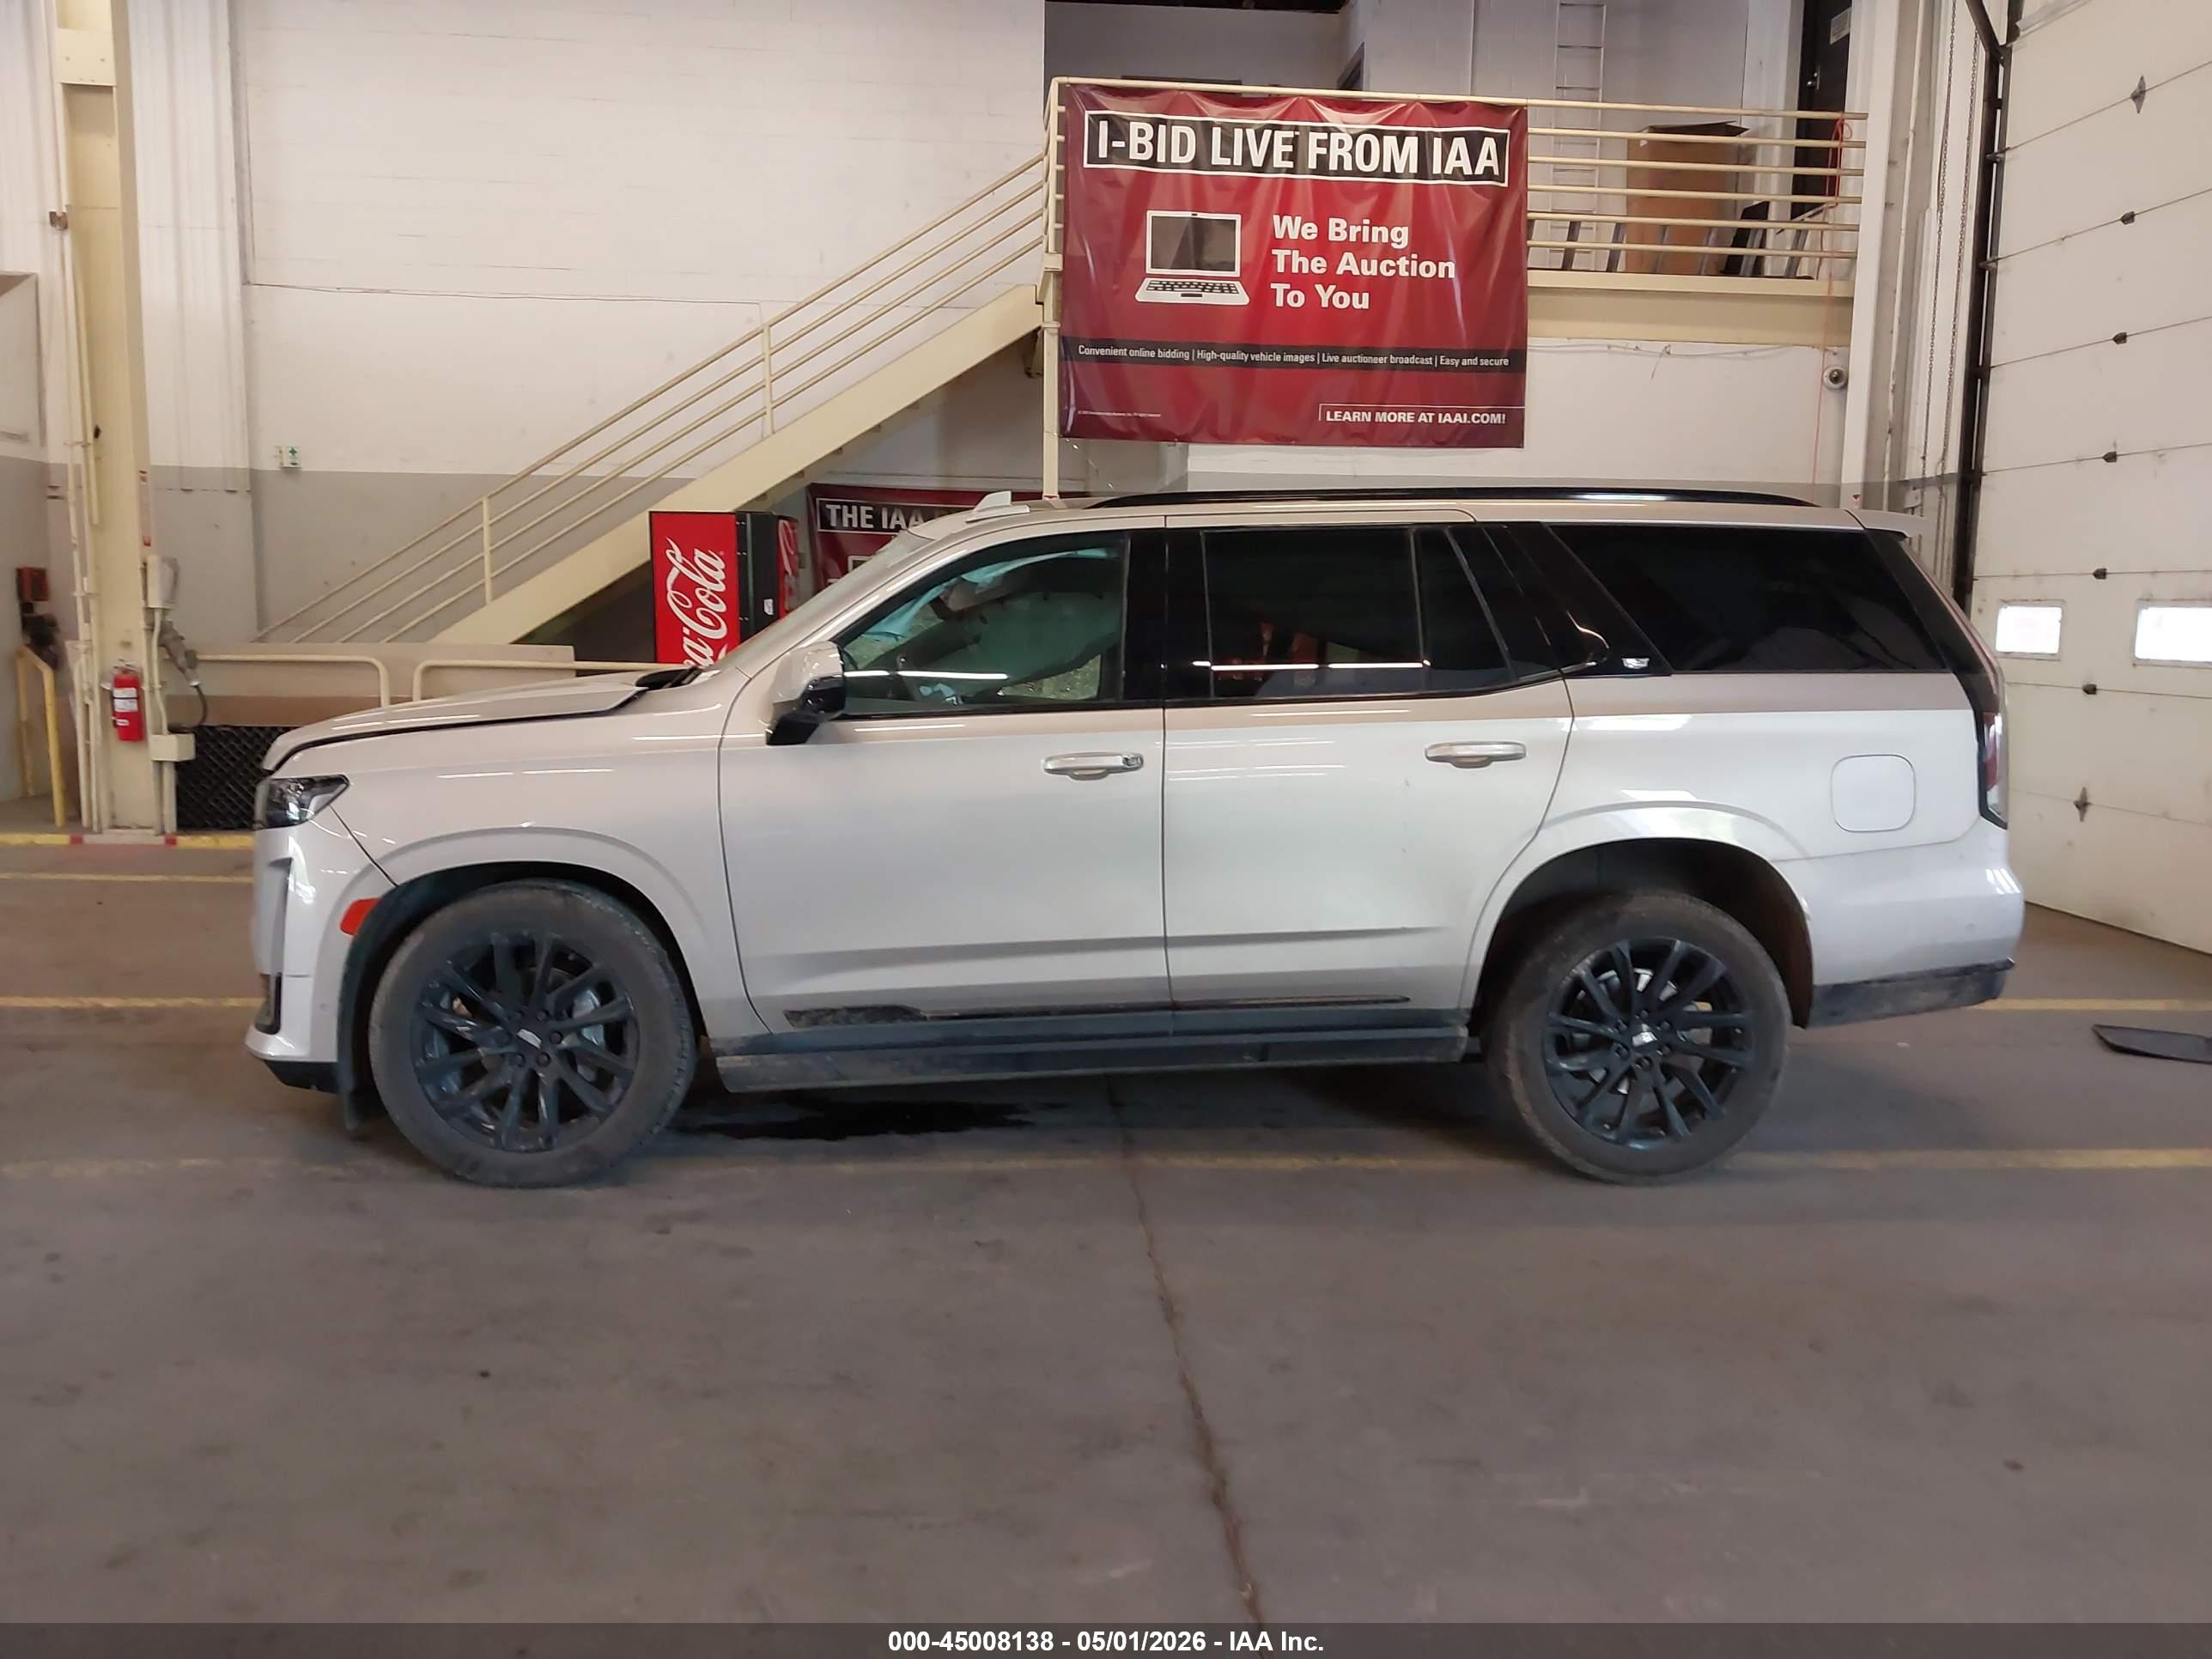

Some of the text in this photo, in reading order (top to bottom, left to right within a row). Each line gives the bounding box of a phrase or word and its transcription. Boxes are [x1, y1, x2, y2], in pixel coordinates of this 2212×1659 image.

[1097, 119, 1501, 176] I-BID LIVE FROM IAA
[1272, 214, 1409, 250] We Bring
[1271, 248, 1455, 279] The Auction
[1270, 283, 1370, 309] To You
[1078, 344, 1127, 357] Convenient
[1129, 347, 1156, 359] online
[1157, 349, 1190, 361] bidding
[1196, 349, 1249, 362] High-quality
[1250, 351, 1281, 362] vehicle
[1282, 352, 1316, 364] images
[1322, 353, 1340, 364] Live
[1341, 353, 1388, 365] auctioneer
[1389, 354, 1433, 366] broadcast
[1439, 355, 1460, 368] Easy
[1462, 356, 1478, 367] and
[1479, 356, 1510, 367] secure
[1326, 410, 1506, 425] LEARN MORE AT IAAI.COM!
[825, 504, 875, 529] THE
